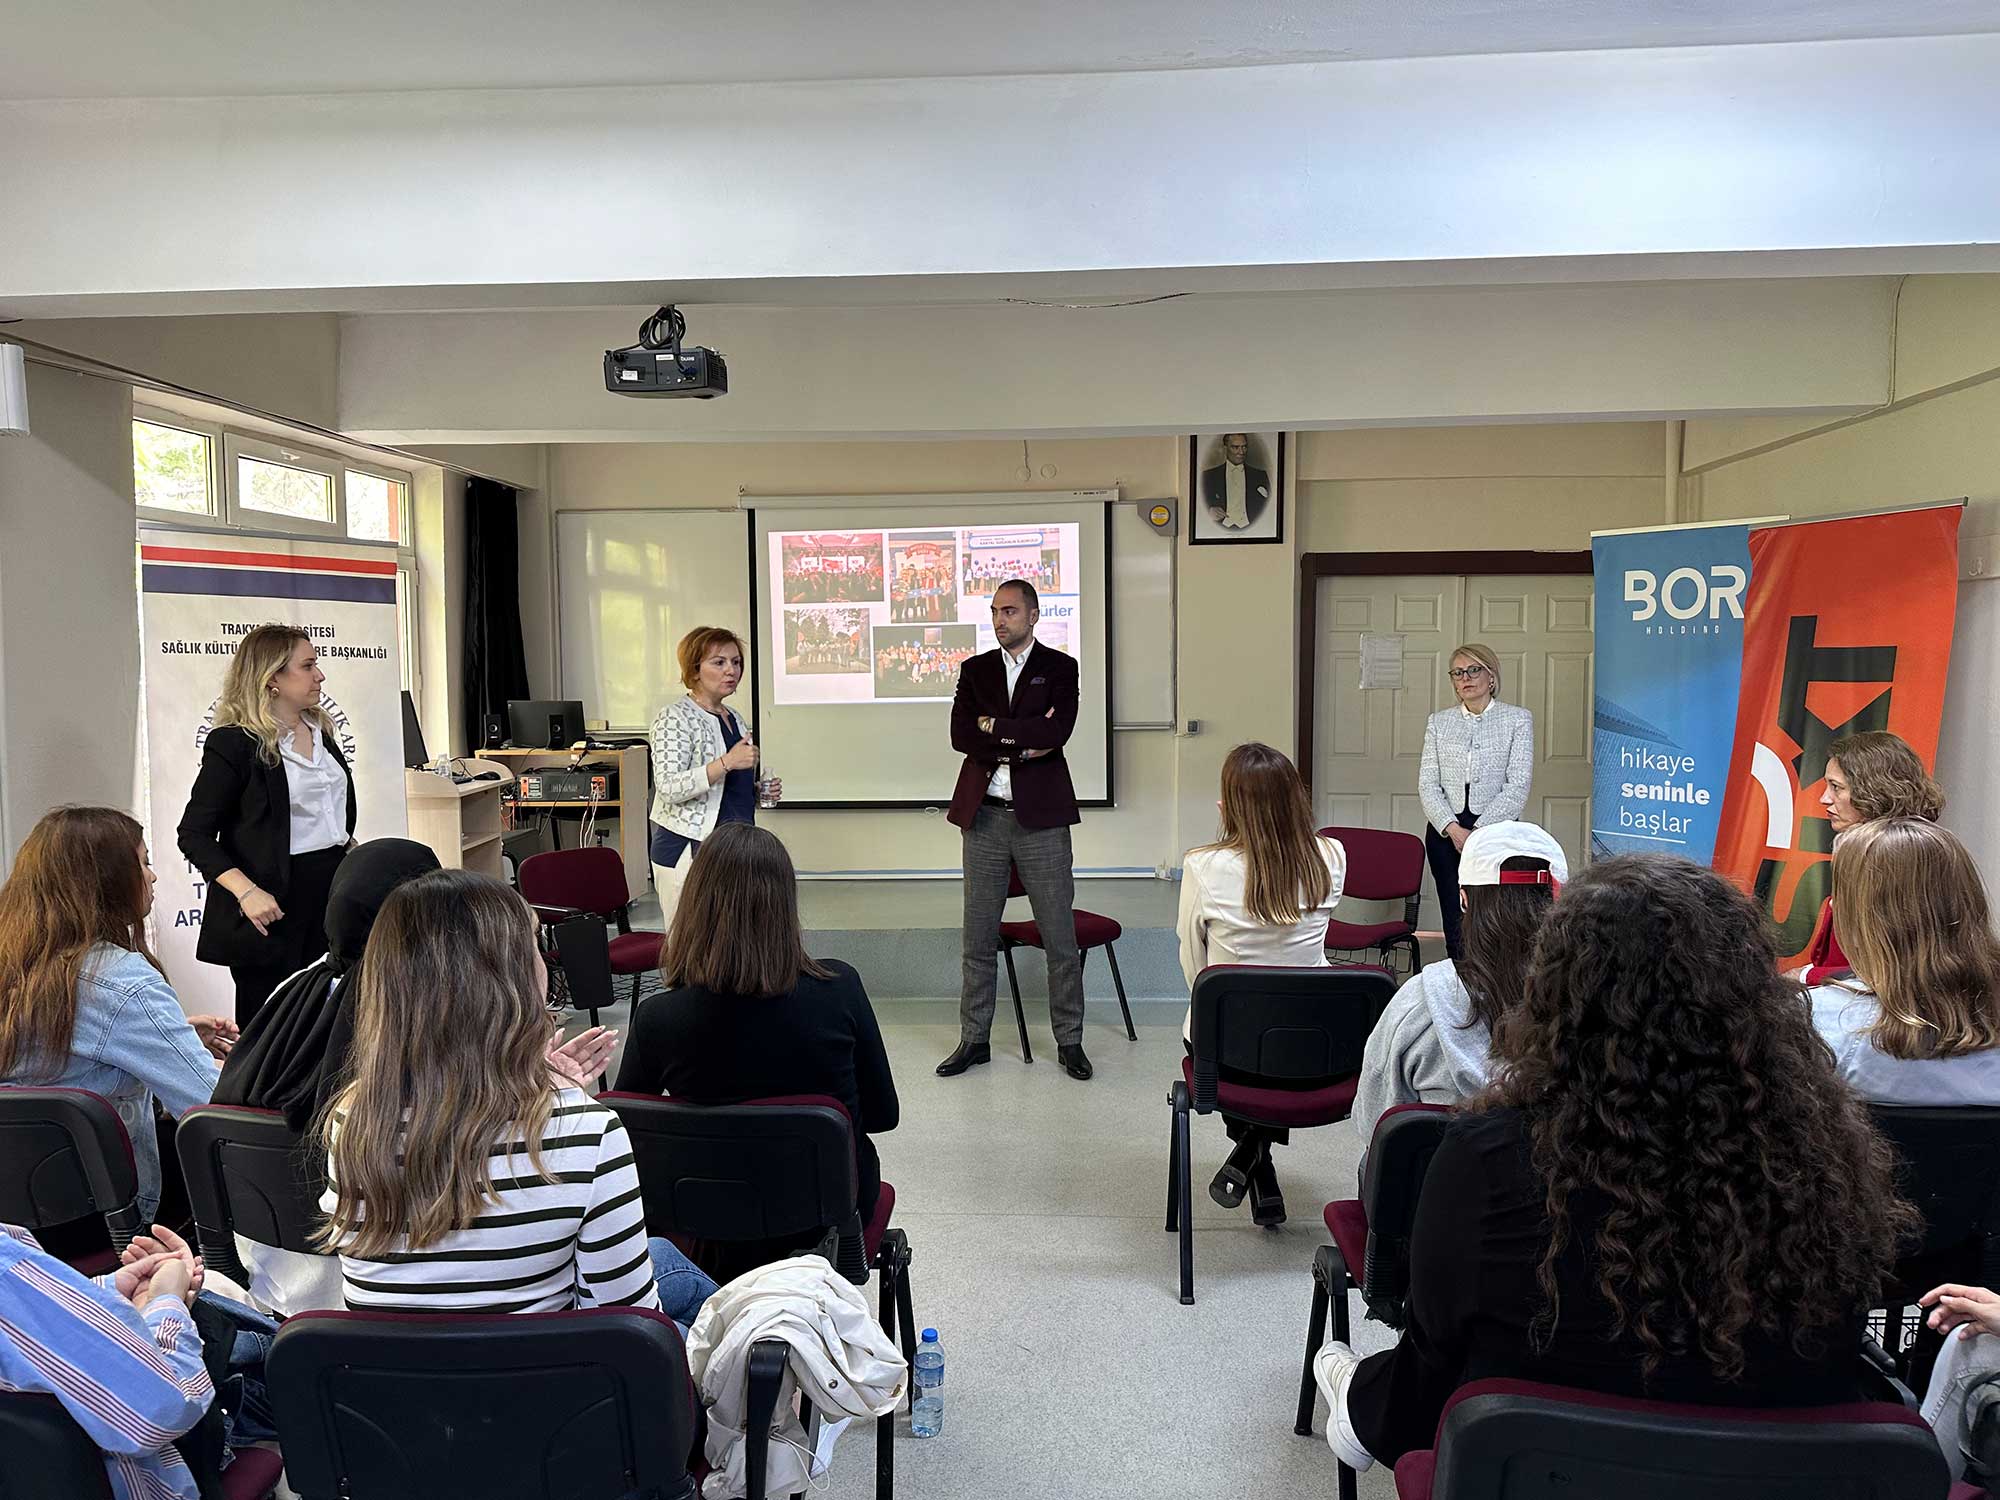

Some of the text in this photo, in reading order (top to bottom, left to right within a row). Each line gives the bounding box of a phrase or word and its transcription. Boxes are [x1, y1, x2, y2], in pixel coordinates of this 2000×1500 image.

[1624, 565, 1747, 621] BOR
[1040, 604, 1073, 617] ürler
[221, 623, 260, 636] TRAKY
[161, 639, 201, 655] SAĞLIK
[204, 640, 240, 656] KÜLTÜ
[331, 645, 387, 661] BAŞKANLIĞI
[1621, 746, 1695, 777] hikaye
[1621, 780, 1710, 805] seninle
[1620, 805, 1692, 835] başlar
